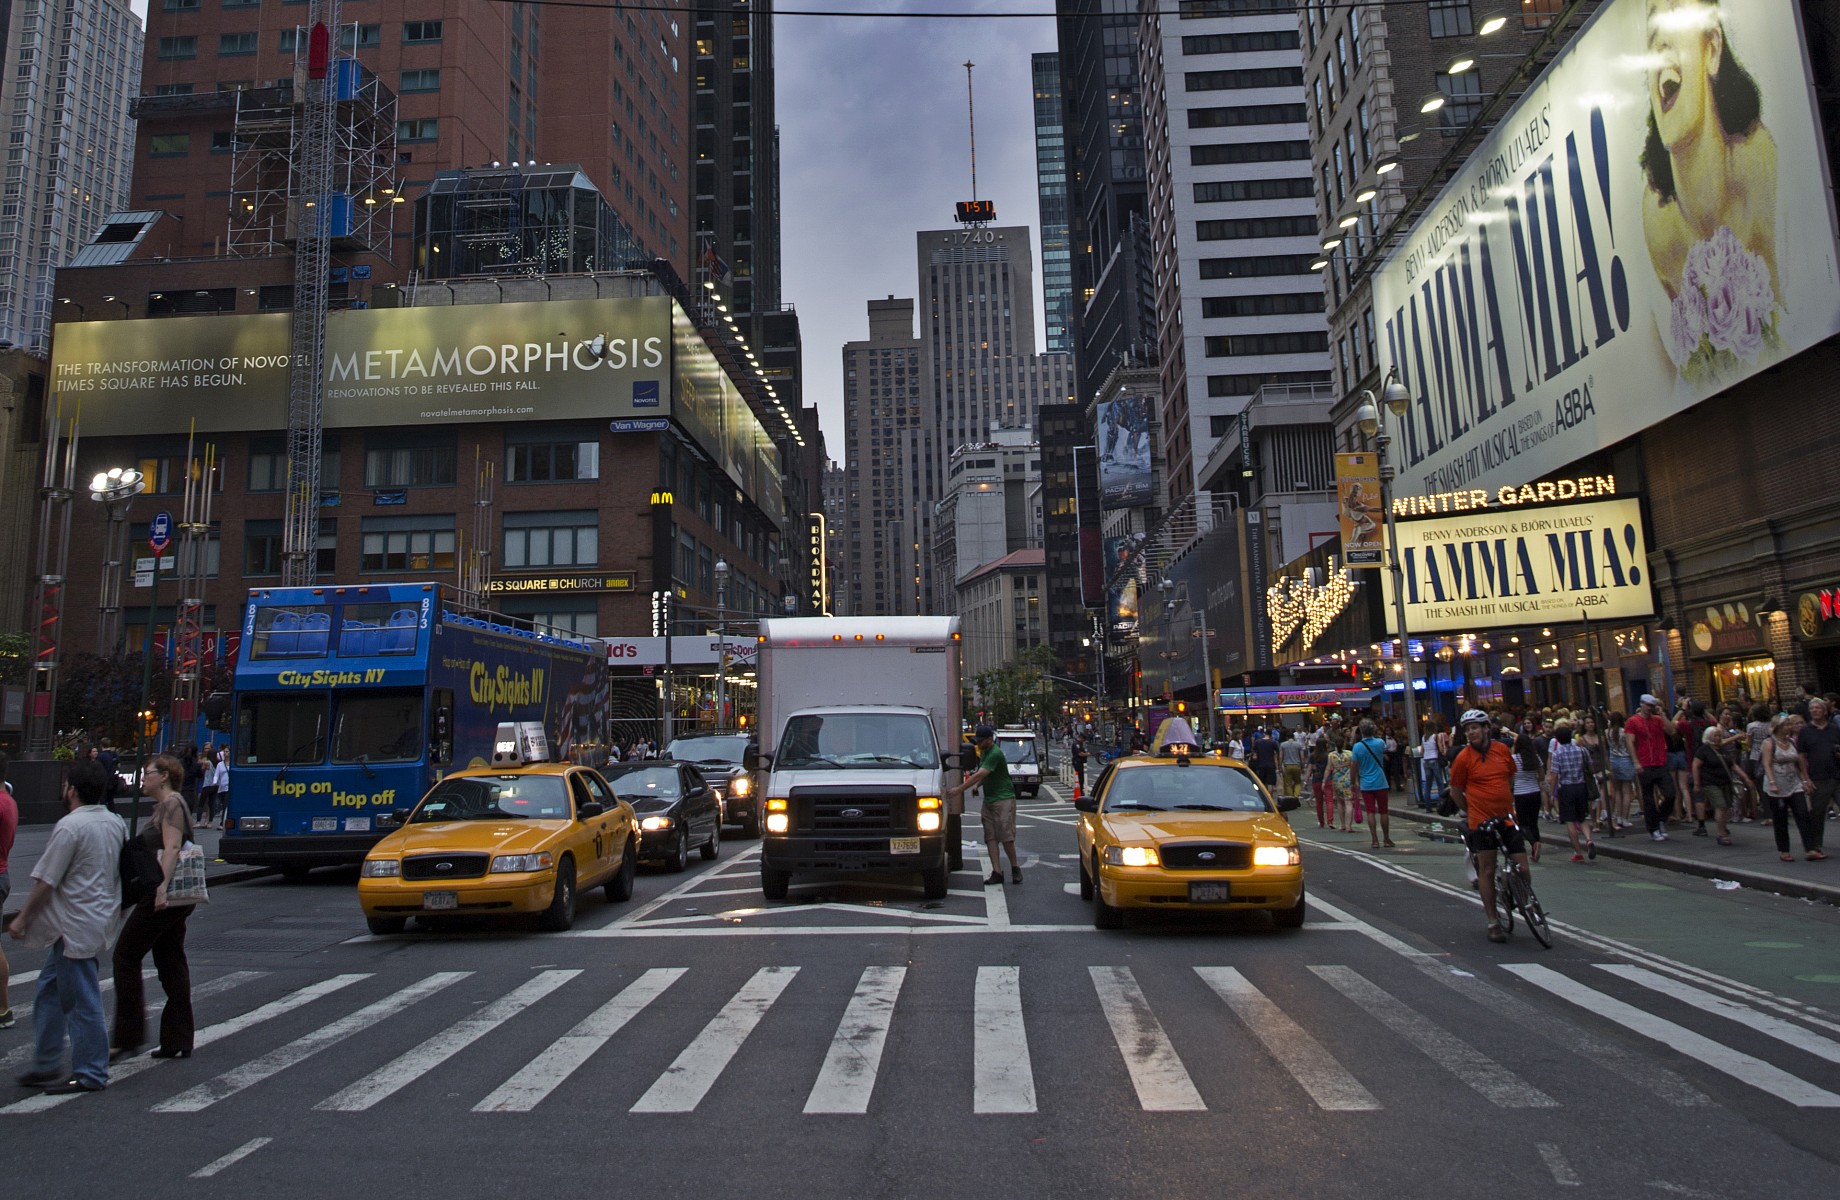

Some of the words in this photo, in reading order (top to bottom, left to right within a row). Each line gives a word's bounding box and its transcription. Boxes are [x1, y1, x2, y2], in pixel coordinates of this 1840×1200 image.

[1427, 196, 1470, 260] ANDERSSON
[1470, 184, 1479, 211] &
[953, 230, 995, 244] 1740
[1386, 222, 1516, 475] MAMMA
[1505, 101, 1631, 394] MIA!
[57, 363, 82, 376] THE
[87, 358, 214, 375] TRANSFORMATION
[219, 357, 239, 370] OF
[328, 336, 663, 382] METAMORPHOSIS
[57, 378, 95, 392] TIMES
[100, 376, 156, 391] SQUARE
[160, 375, 189, 388] HAS
[194, 373, 247, 387] BEGUN.
[328, 386, 400, 399] RENOVATIONS
[404, 386, 418, 395] TO
[421, 385, 433, 395] BE
[436, 383, 487, 394] REVEALED
[490, 381, 512, 392] THIS
[515, 380, 541, 391] FALL.
[420, 405, 534, 419] novotelmetamorphosis.com
[1518, 414, 1534, 435] BASED
[1533, 409, 1543, 426] ON
[1520, 435, 1530, 451] THE
[1530, 425, 1548, 448] SONGS
[1548, 421, 1557, 439] OF
[1555, 382, 1596, 435] ABBA
[614, 421, 631, 431] Van
[632, 419, 667, 432] Wagner
[1241, 412, 1251, 467] STARBUCKS
[1423, 468, 1438, 499] THE
[1438, 457, 1465, 492] SMASH
[1465, 446, 1479, 483] HIT
[1480, 423, 1521, 474] MUSICAL
[1386, 488, 1489, 517] WINTER
[1498, 475, 1616, 505] GARDEN
[1422, 529, 1452, 542] BENNY
[1454, 526, 1508, 539] ANDERSSON
[1510, 525, 1519, 534] &
[1521, 519, 1551, 533] BJÖRN
[811, 525, 820, 608] BROADWAY
[1386, 536, 1540, 606] MAMMA
[1545, 523, 1641, 594] MIA!
[505, 579, 547, 590] SQUARE
[559, 578, 602, 589] CHURCH
[606, 578, 629, 588] annex
[1252, 542, 1262, 584] MANHATTAN
[1259, 644, 1267, 667] HOTEL
[1424, 608, 1443, 619] THE
[1445, 606, 1478, 618] SMASH
[1480, 603, 1496, 615] HIT
[1499, 601, 1540, 614] MUSICAL
[1575, 595, 1608, 607] ABBA
[246, 604, 256, 636] 873
[420, 598, 430, 629] 873
[365, 668, 385, 683] NY
[531, 667, 544, 704] NY
[1277, 691, 1323, 704] STARDUST
[272, 780, 306, 797] Hop
[310, 782, 332, 794] on
[332, 791, 367, 809] Hop
[371, 790, 395, 805] off
